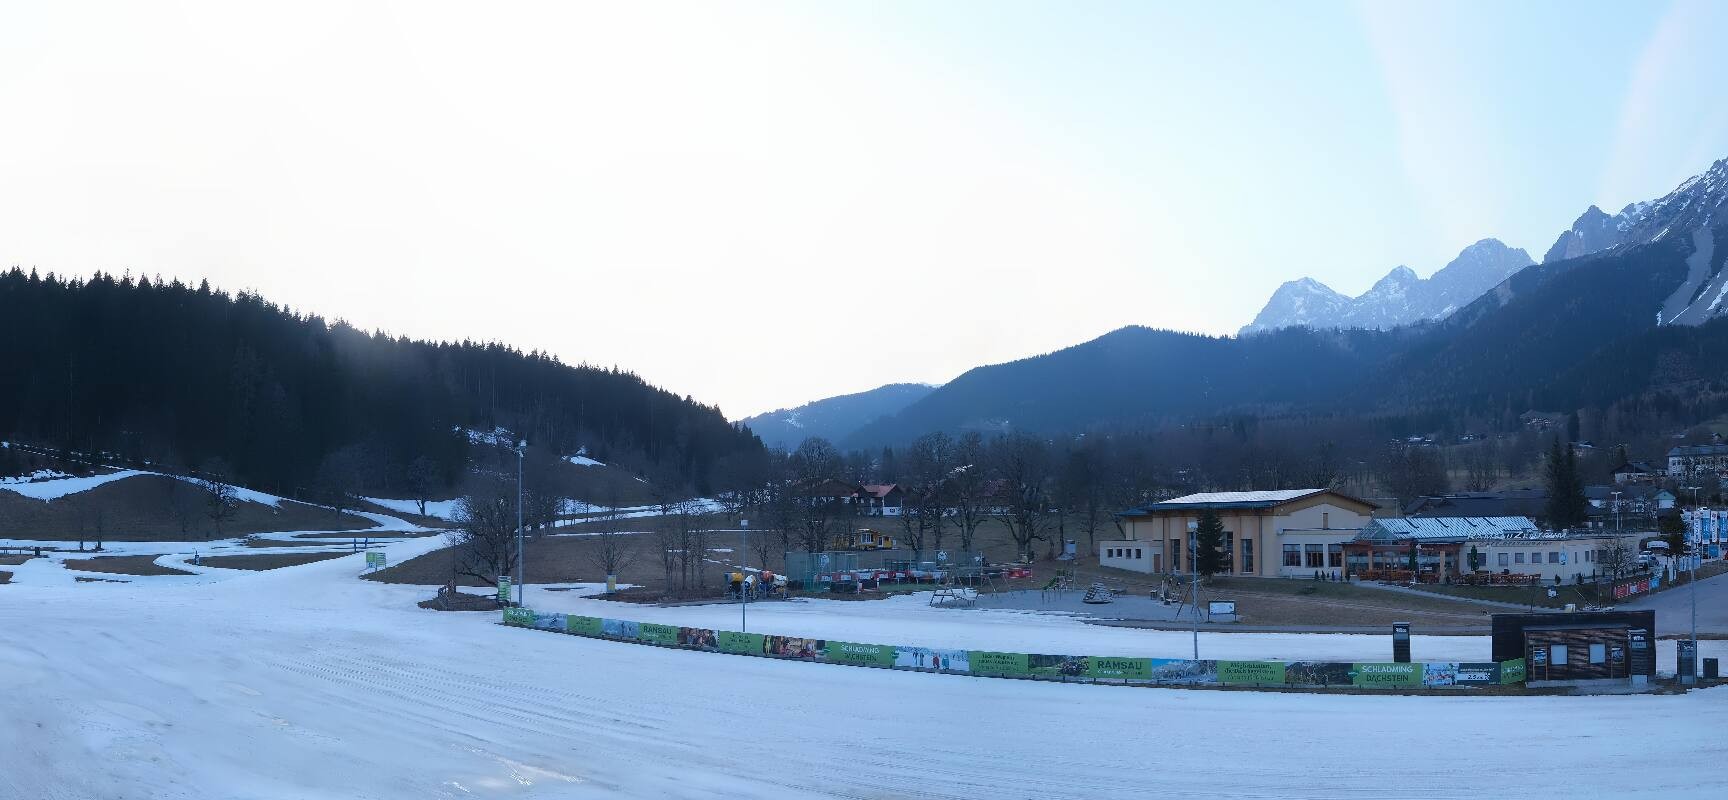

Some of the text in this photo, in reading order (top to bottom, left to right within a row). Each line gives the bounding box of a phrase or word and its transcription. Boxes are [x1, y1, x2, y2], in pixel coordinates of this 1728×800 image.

[1097, 660, 1142, 670] RAMSAU
[1362, 665, 1414, 673] SCHLADMING
[1366, 674, 1409, 683] DACHSTEIN
